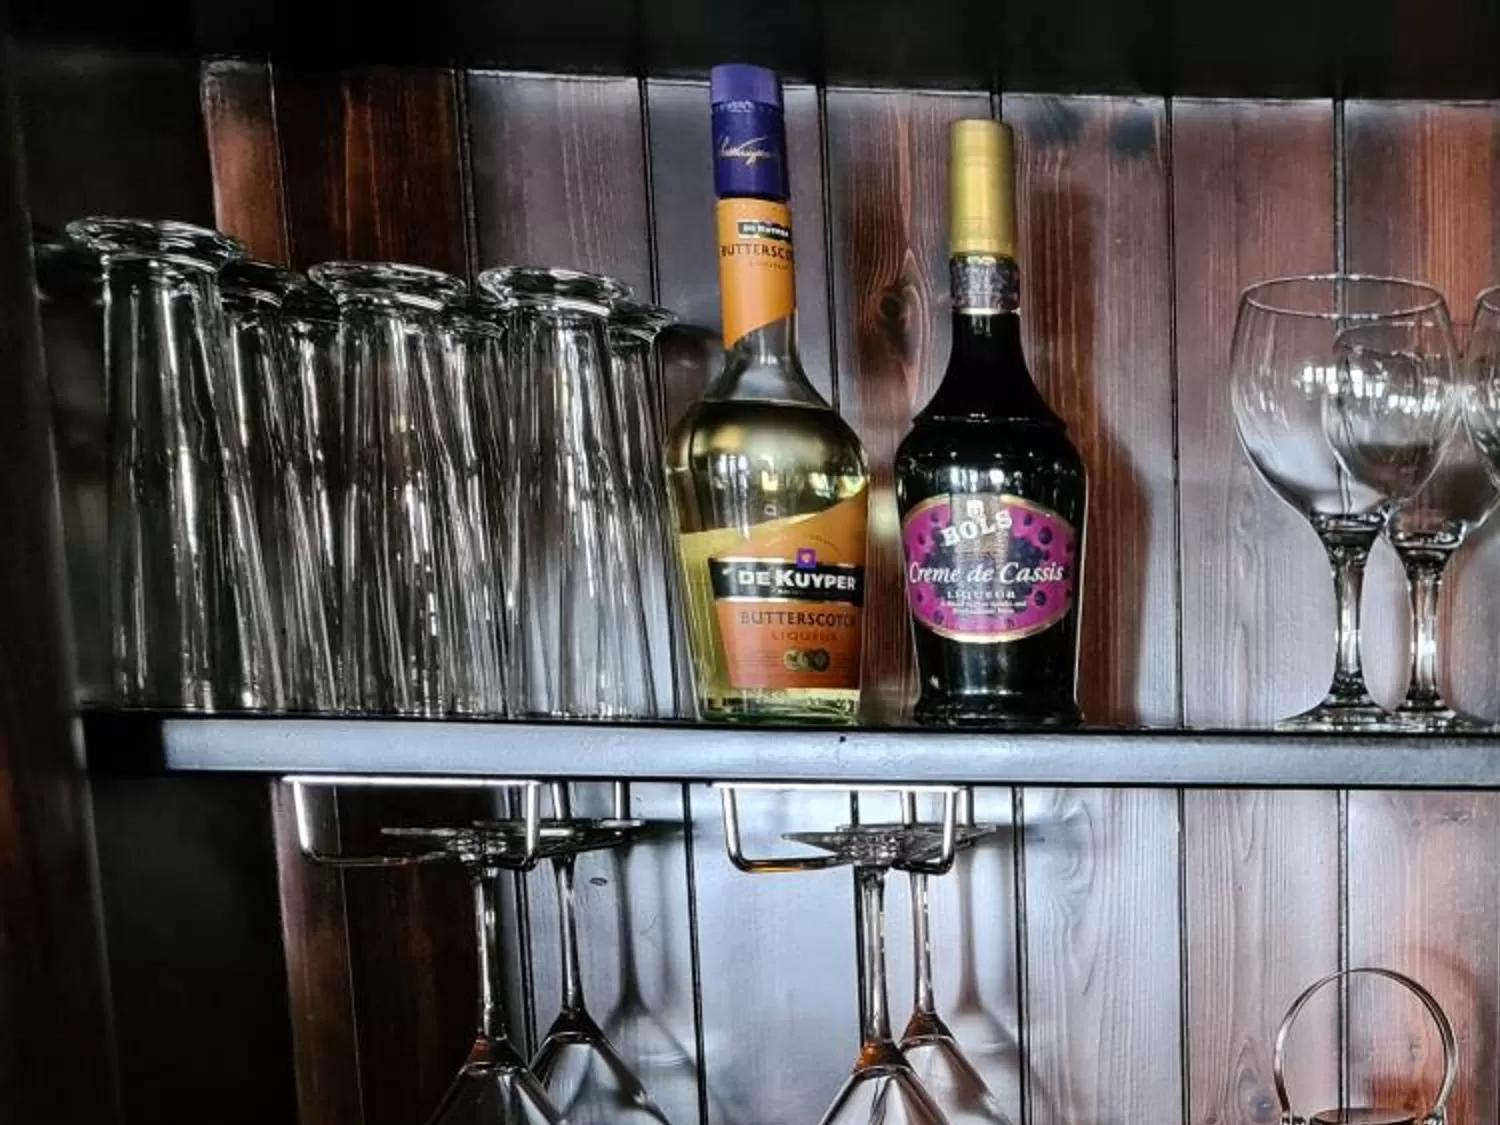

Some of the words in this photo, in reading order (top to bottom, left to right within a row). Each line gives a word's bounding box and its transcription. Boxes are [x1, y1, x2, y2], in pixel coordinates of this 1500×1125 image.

[941, 510, 1012, 547] BOLS
[739, 570, 771, 585] DE
[775, 570, 857, 591] KUYPER
[909, 561, 961, 583] Creme
[967, 562, 994, 582] de
[1000, 561, 1064, 583] Cassis
